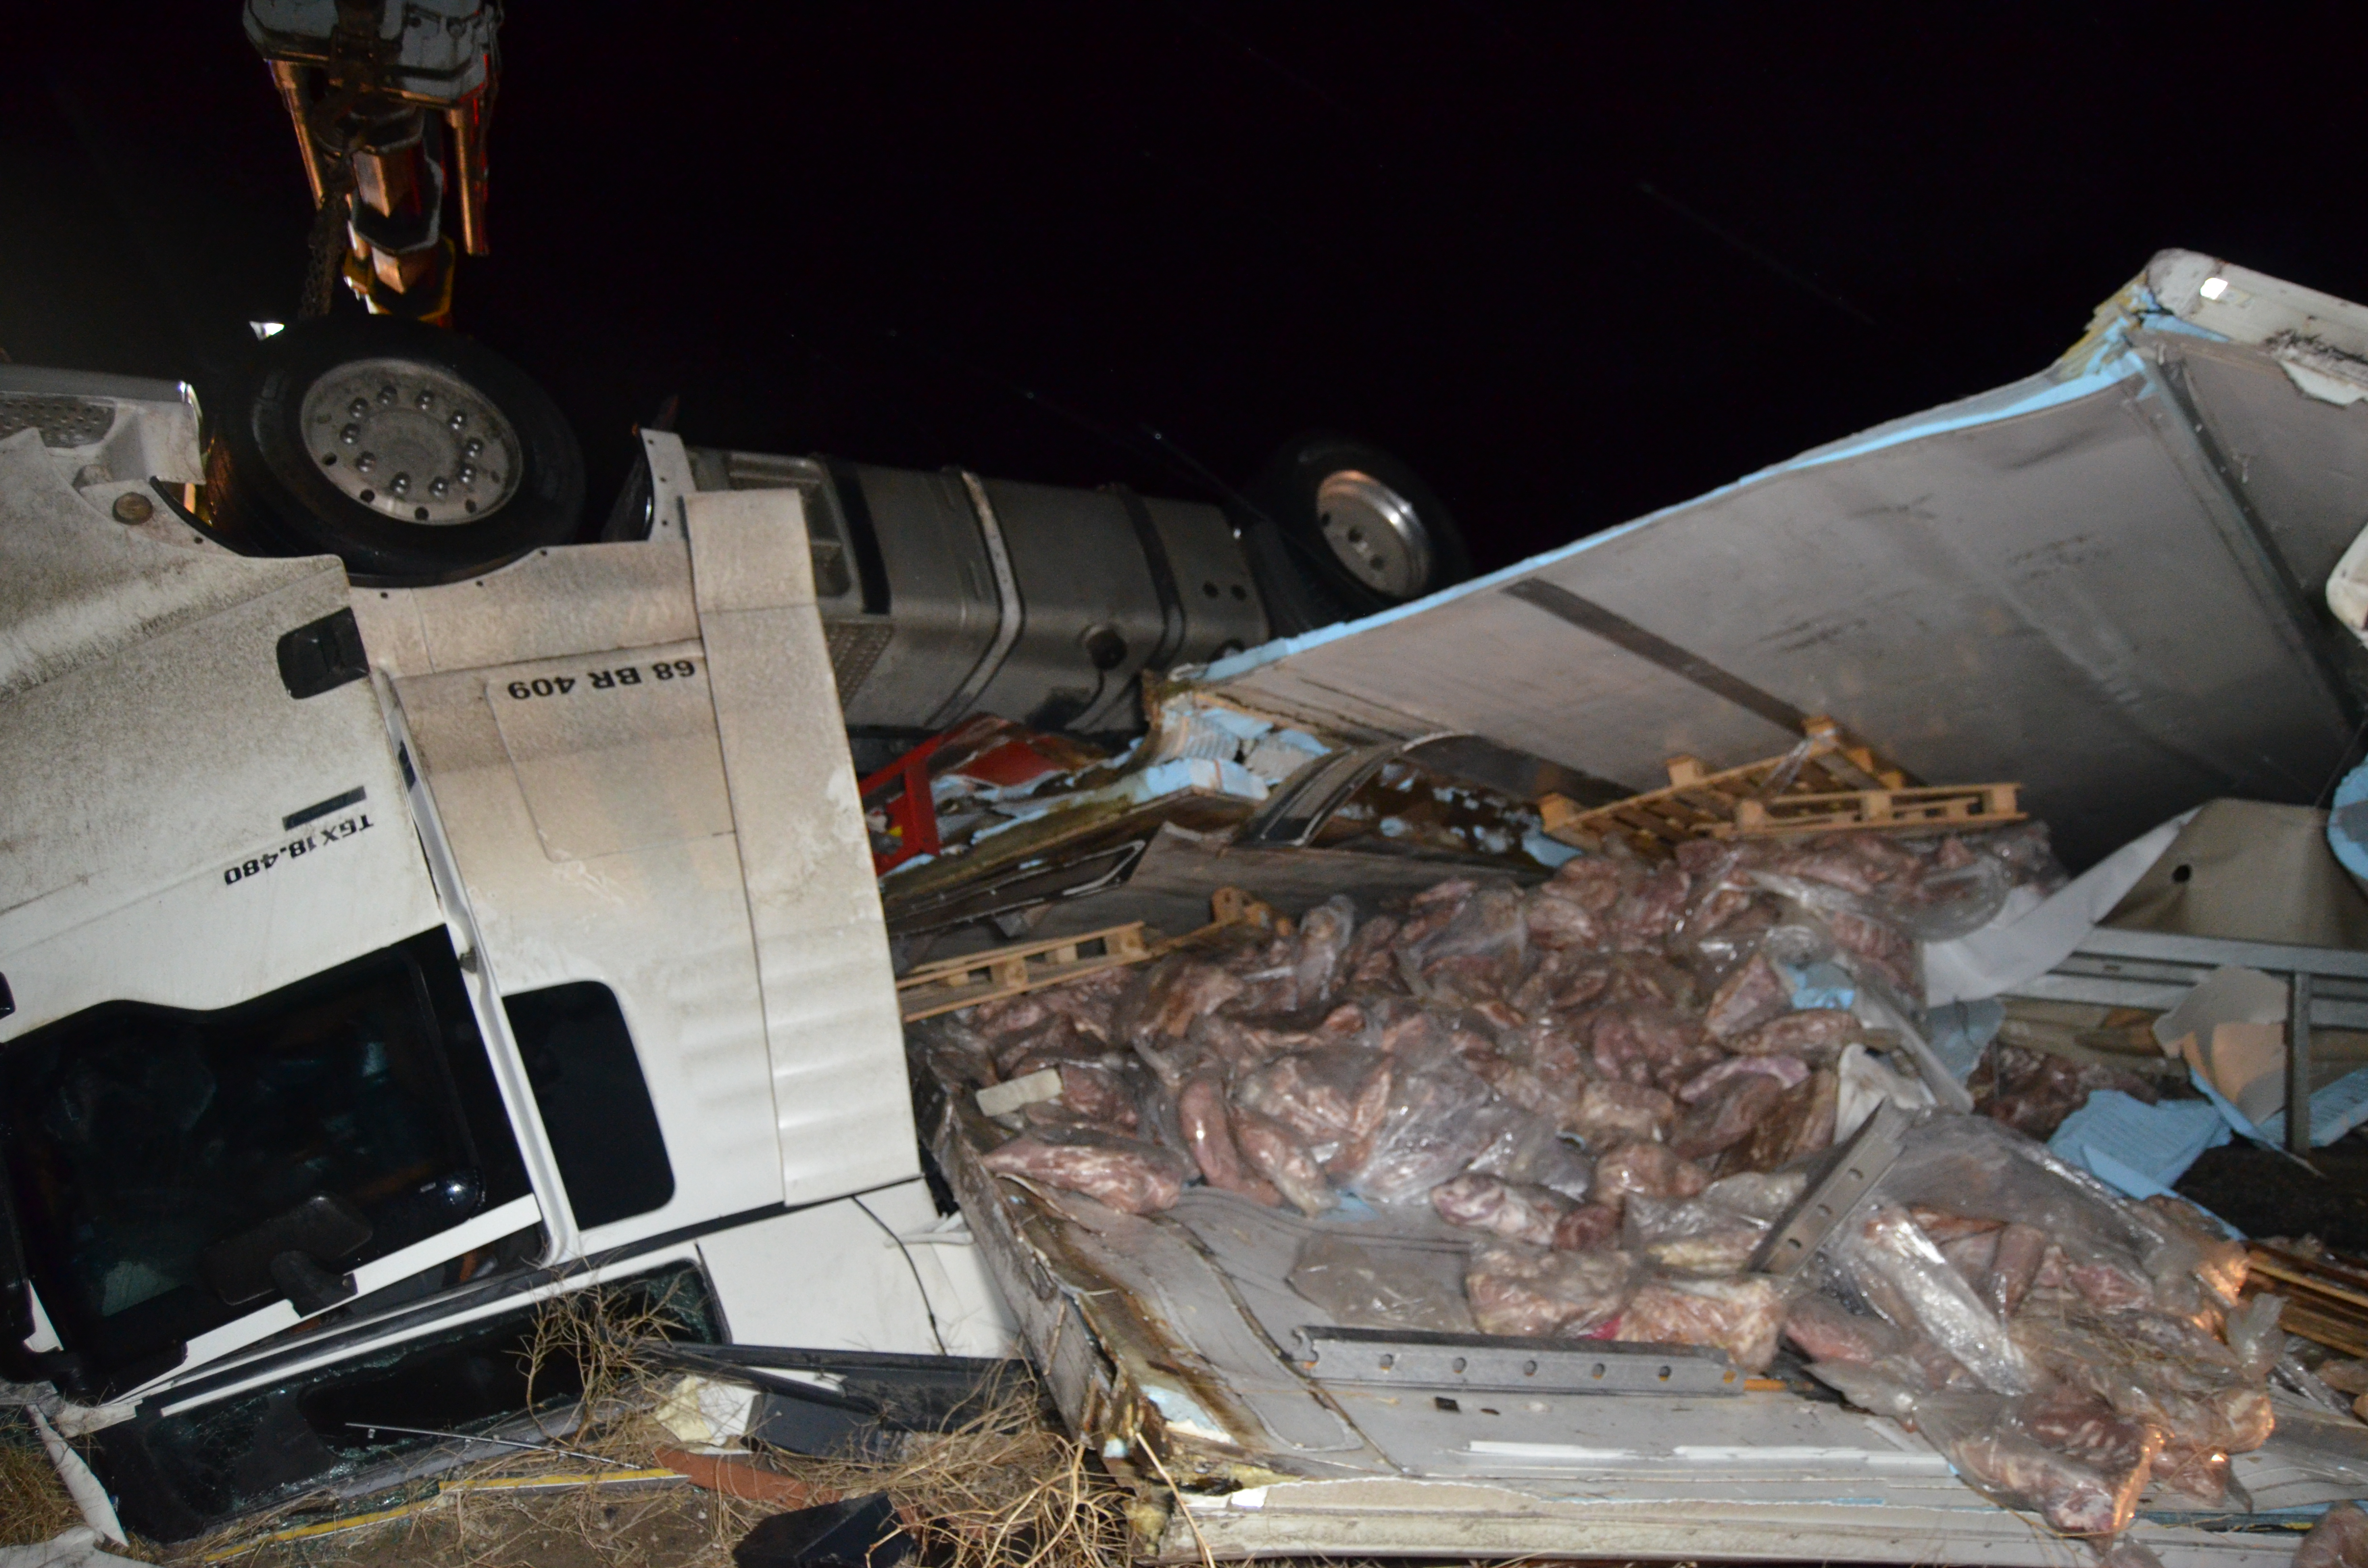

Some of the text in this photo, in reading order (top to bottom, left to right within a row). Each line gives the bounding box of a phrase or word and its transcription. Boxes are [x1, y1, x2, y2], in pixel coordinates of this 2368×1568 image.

[507, 660, 695, 699] 68 BR 409
[223, 814, 374, 885] TGX 18.480
